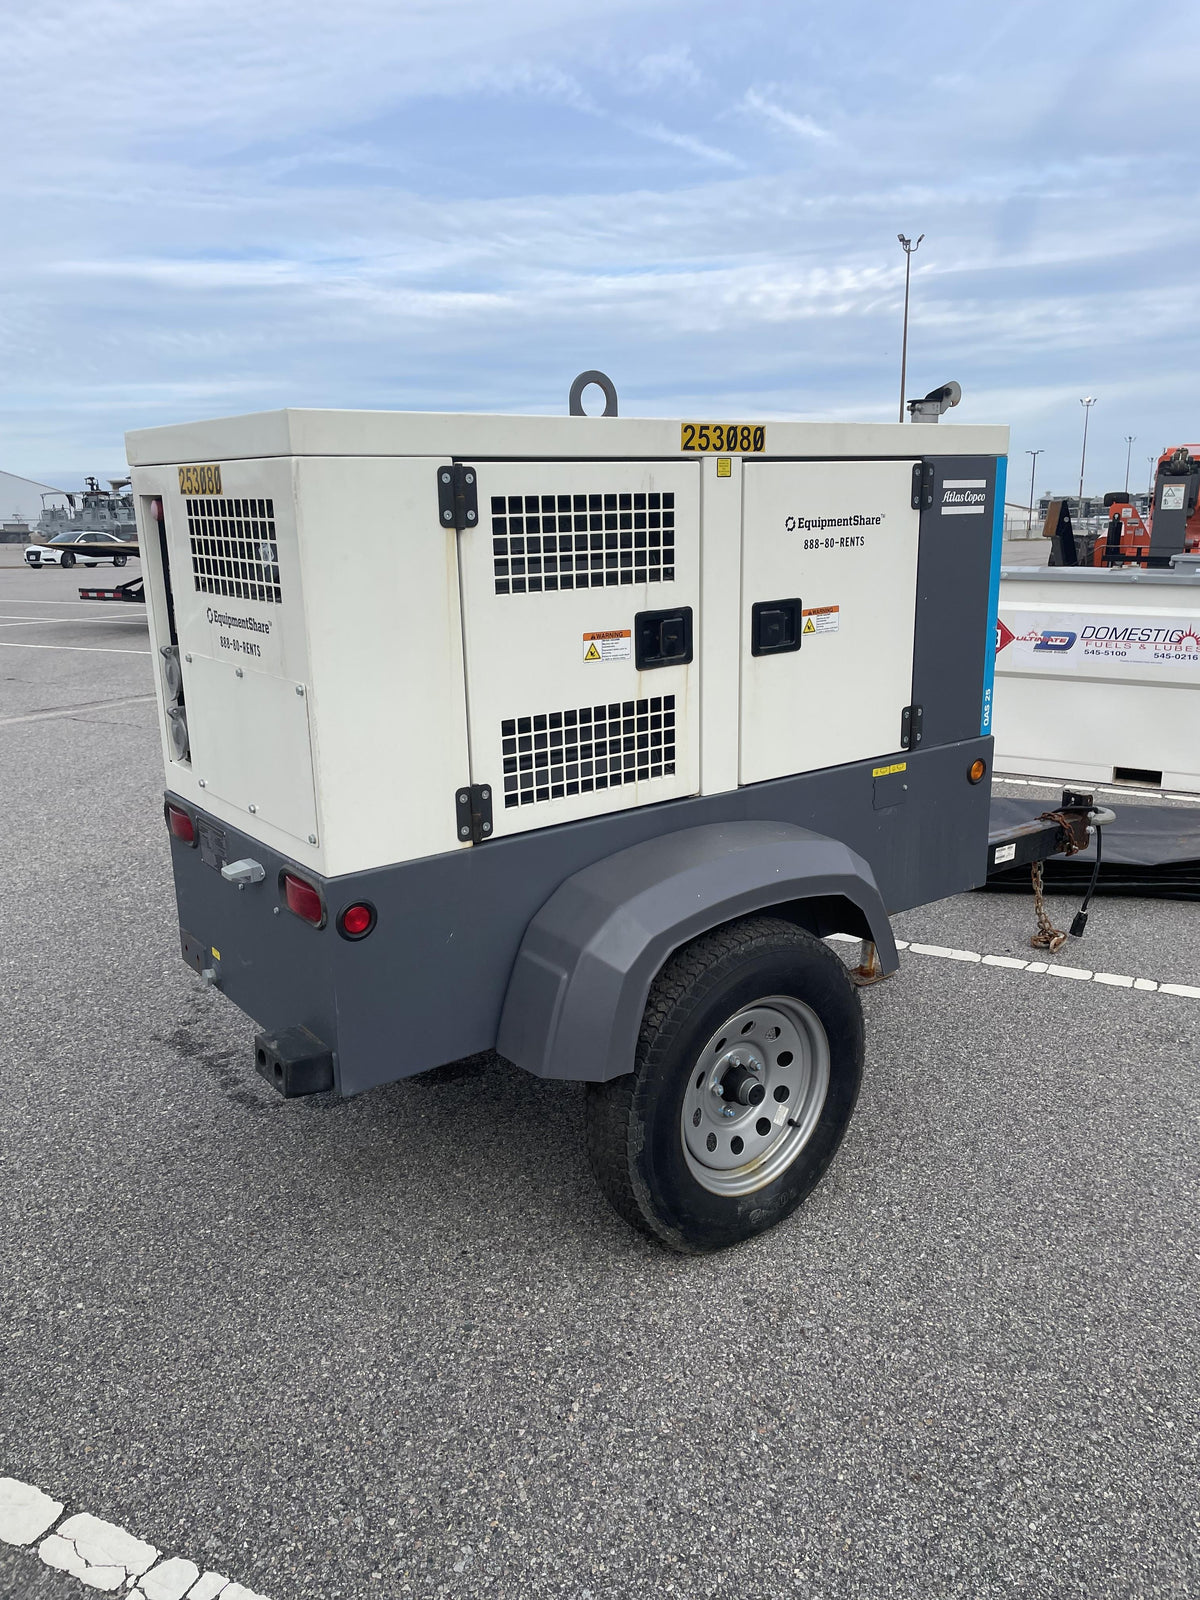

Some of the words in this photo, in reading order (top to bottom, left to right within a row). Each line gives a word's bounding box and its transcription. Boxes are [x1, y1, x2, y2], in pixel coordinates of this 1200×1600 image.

[682, 424, 765, 452] 253080
[178, 466, 221, 494] 253080
[804, 536, 865, 550] 888-80-RENTS
[596, 631, 624, 640] WARNING
[1080, 625, 1185, 643] DOMESTIC
[220, 636, 261, 657] 888-80-RENTS
[1085, 641, 1132, 650] FUELS
[1084, 649, 1127, 657] 545-5100
[1153, 652, 1199, 661] 545-0216
[985, 688, 991, 702] 25
